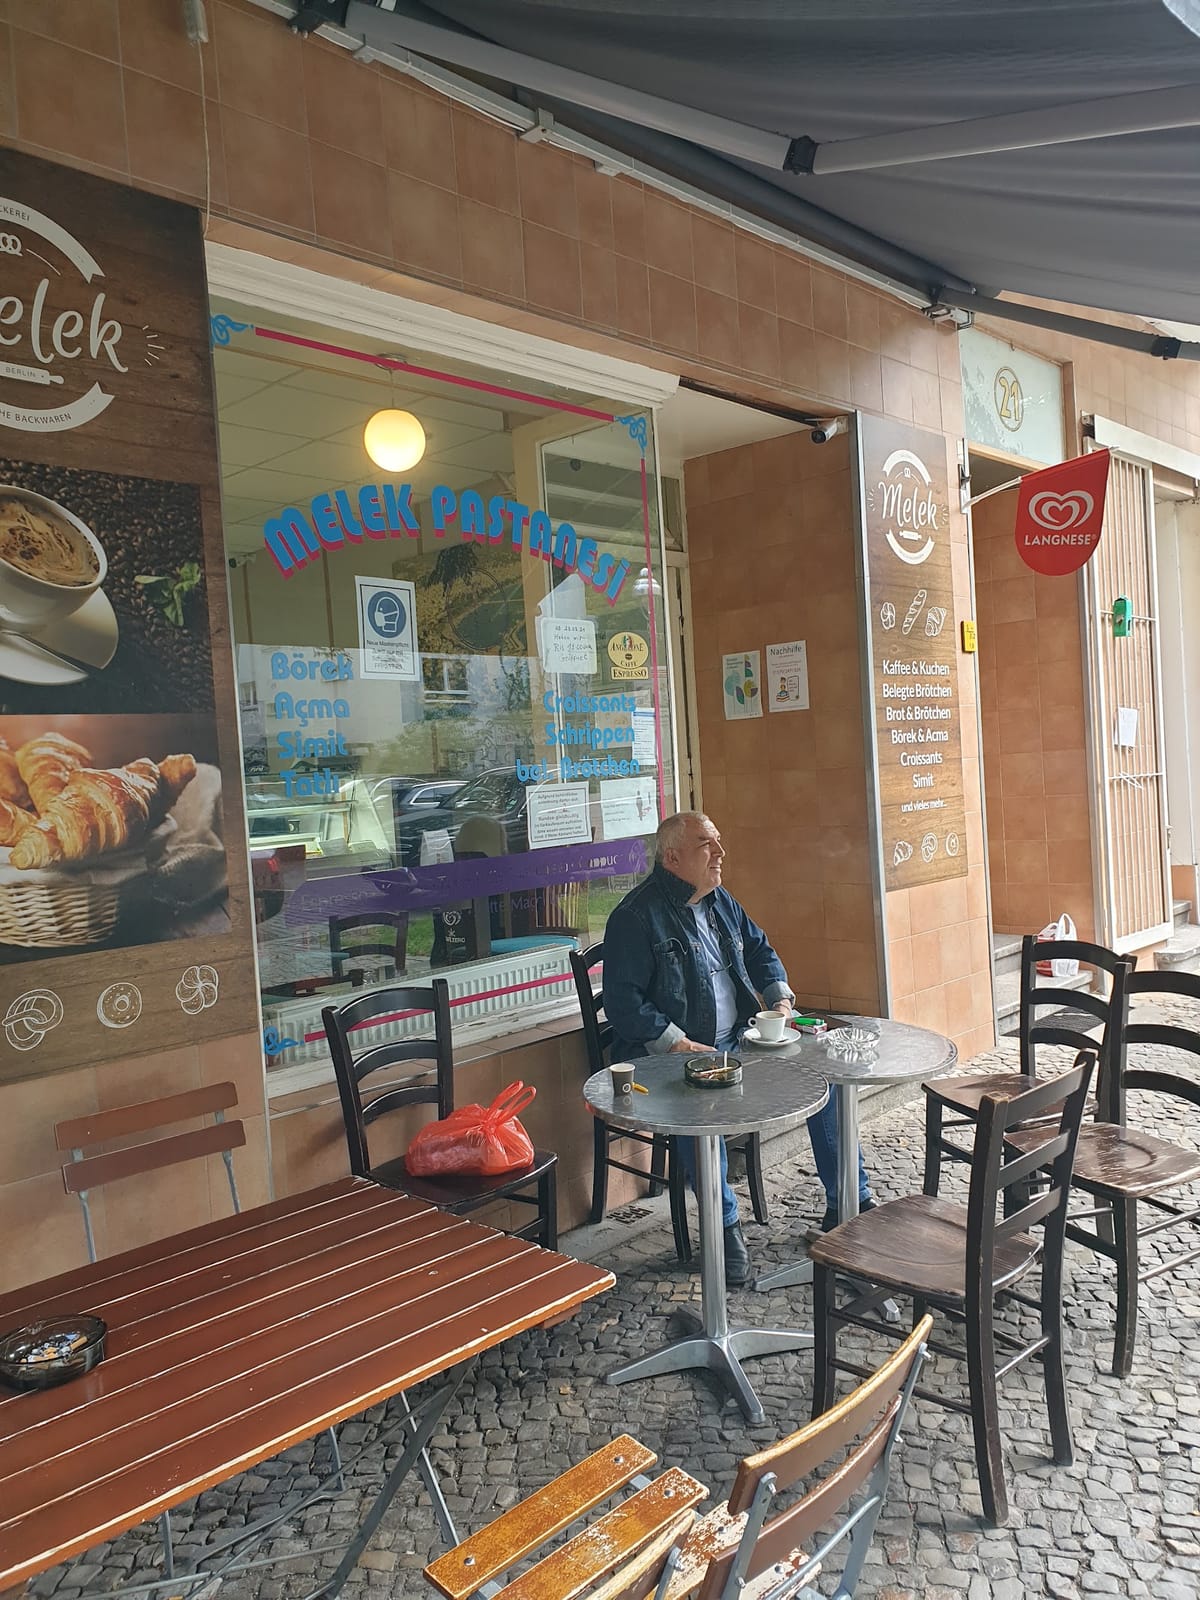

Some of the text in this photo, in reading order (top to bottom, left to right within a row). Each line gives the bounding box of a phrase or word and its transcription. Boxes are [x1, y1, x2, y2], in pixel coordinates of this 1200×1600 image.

[0, 279, 129, 373] elek
[5, 366, 37, 379] BERLIN
[998, 376, 1020, 422] 21
[15, 412, 72, 425] BACKWAREN
[878, 481, 939, 531] Melek
[264, 484, 420, 581] MELEK
[1024, 534, 1091, 546] LANGNESE
[770, 645, 802, 656] Nachhilfe
[271, 652, 354, 681] Börek
[613, 669, 647, 678] ESPRESSO
[883, 660, 950, 676] Kaffee & Kuchen
[883, 683, 952, 701] Belegte Brötchen
[274, 691, 350, 728] Açma
[543, 690, 636, 714] Croissants
[886, 705, 951, 720] Brot & Brötchen
[277, 729, 349, 760] Simit
[545, 721, 635, 751] Schrippen
[891, 729, 917, 744] Börek
[917, 728, 925, 743] &
[900, 751, 943, 767] Croissants
[516, 755, 640, 783] bel. Brötchen
[912, 773, 934, 788] Simit
[901, 801, 913, 813] und
[914, 800, 929, 811] vieles
